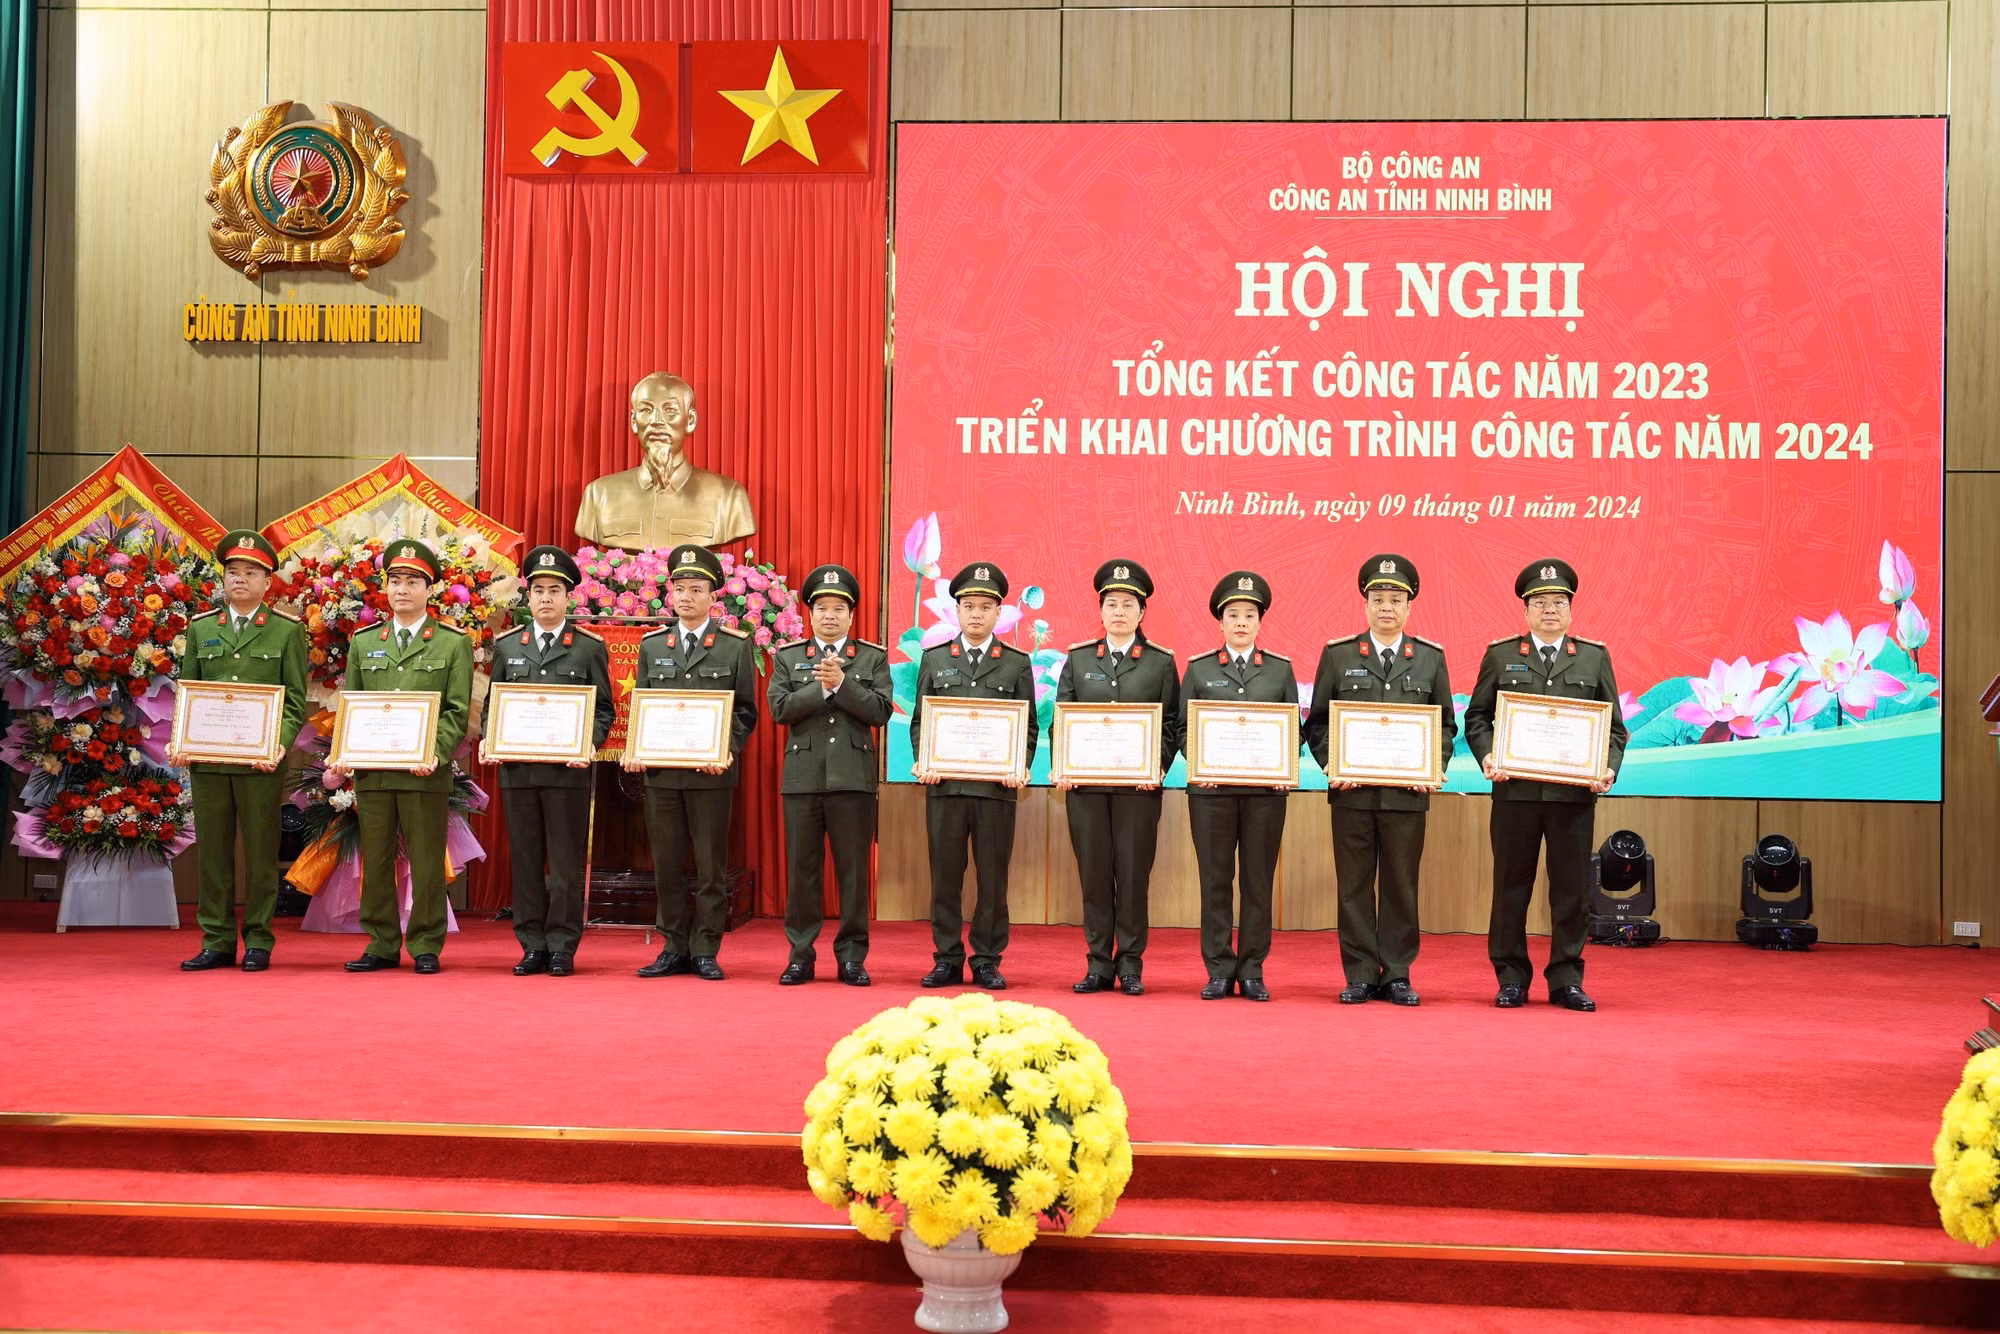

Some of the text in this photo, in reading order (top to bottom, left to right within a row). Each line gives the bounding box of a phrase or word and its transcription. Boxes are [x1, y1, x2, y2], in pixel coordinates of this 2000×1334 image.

[1342, 151, 1480, 184] BỘ CÔNG AN
[1268, 180, 1552, 211] CÔNG AN TỈNH NINH BÌNH
[1234, 244, 1585, 333] HỘI NGHỊ
[184, 289, 421, 343] CÔNG AN TỈNH NINH BÌNH
[1111, 339, 1709, 400] TỔNG KẾT CÔNG TÁC NĂM 2023
[955, 397, 1874, 461] TRIỂN KHAI CHƯƠNG TRÌNH CÔNG TÁC NĂM 2024
[153, 483, 195, 524] Chúc
[415, 480, 453, 515] Chúc
[1174, 490, 1642, 524] Ninh Bình, ngày 09 tháng 01 năm 2024
[609, 640, 641, 654] CÔN
